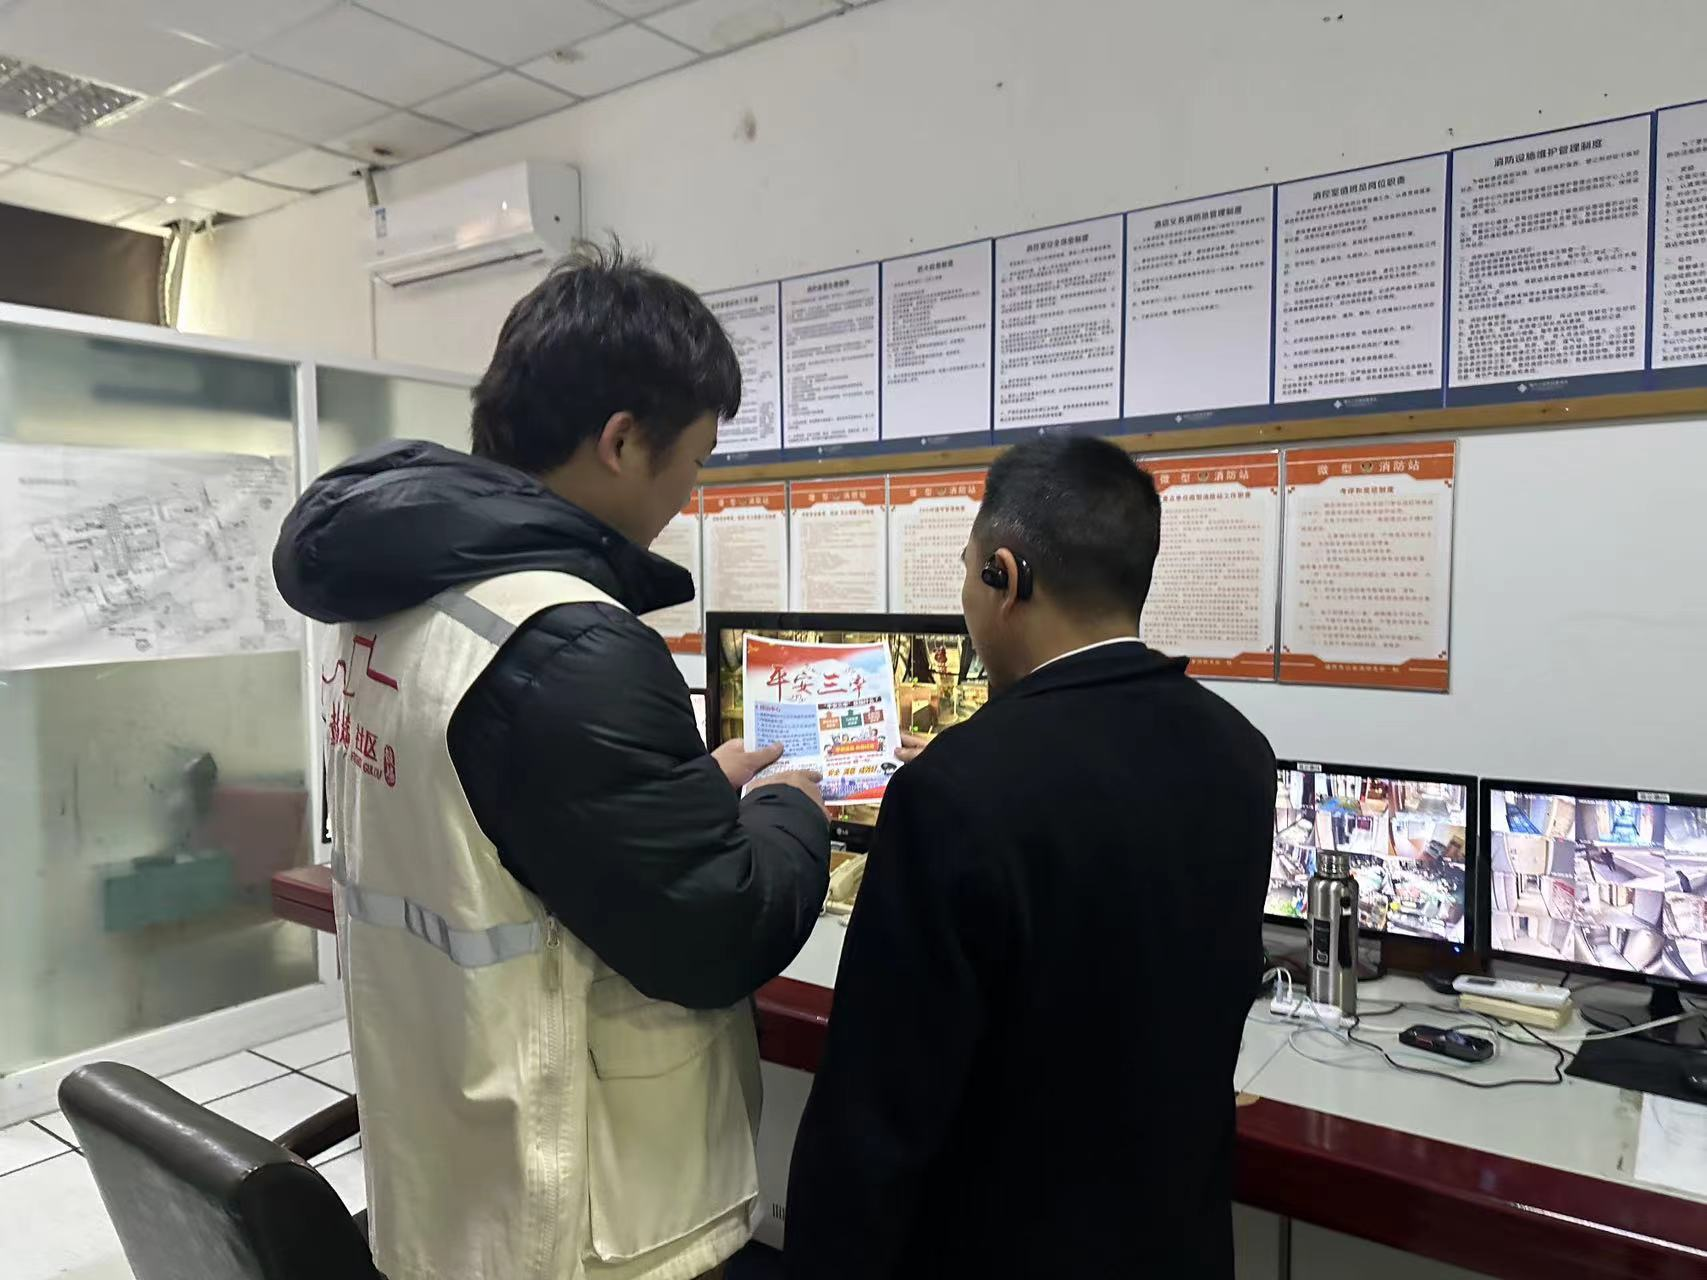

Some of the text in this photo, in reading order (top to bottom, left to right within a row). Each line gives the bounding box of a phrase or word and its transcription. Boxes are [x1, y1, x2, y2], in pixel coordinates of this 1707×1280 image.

[1494, 138, 1603, 167] 消防设施维护管理制度
[1214, 469, 1249, 482] 消防站
[1317, 460, 1420, 476] 微型 消防站
